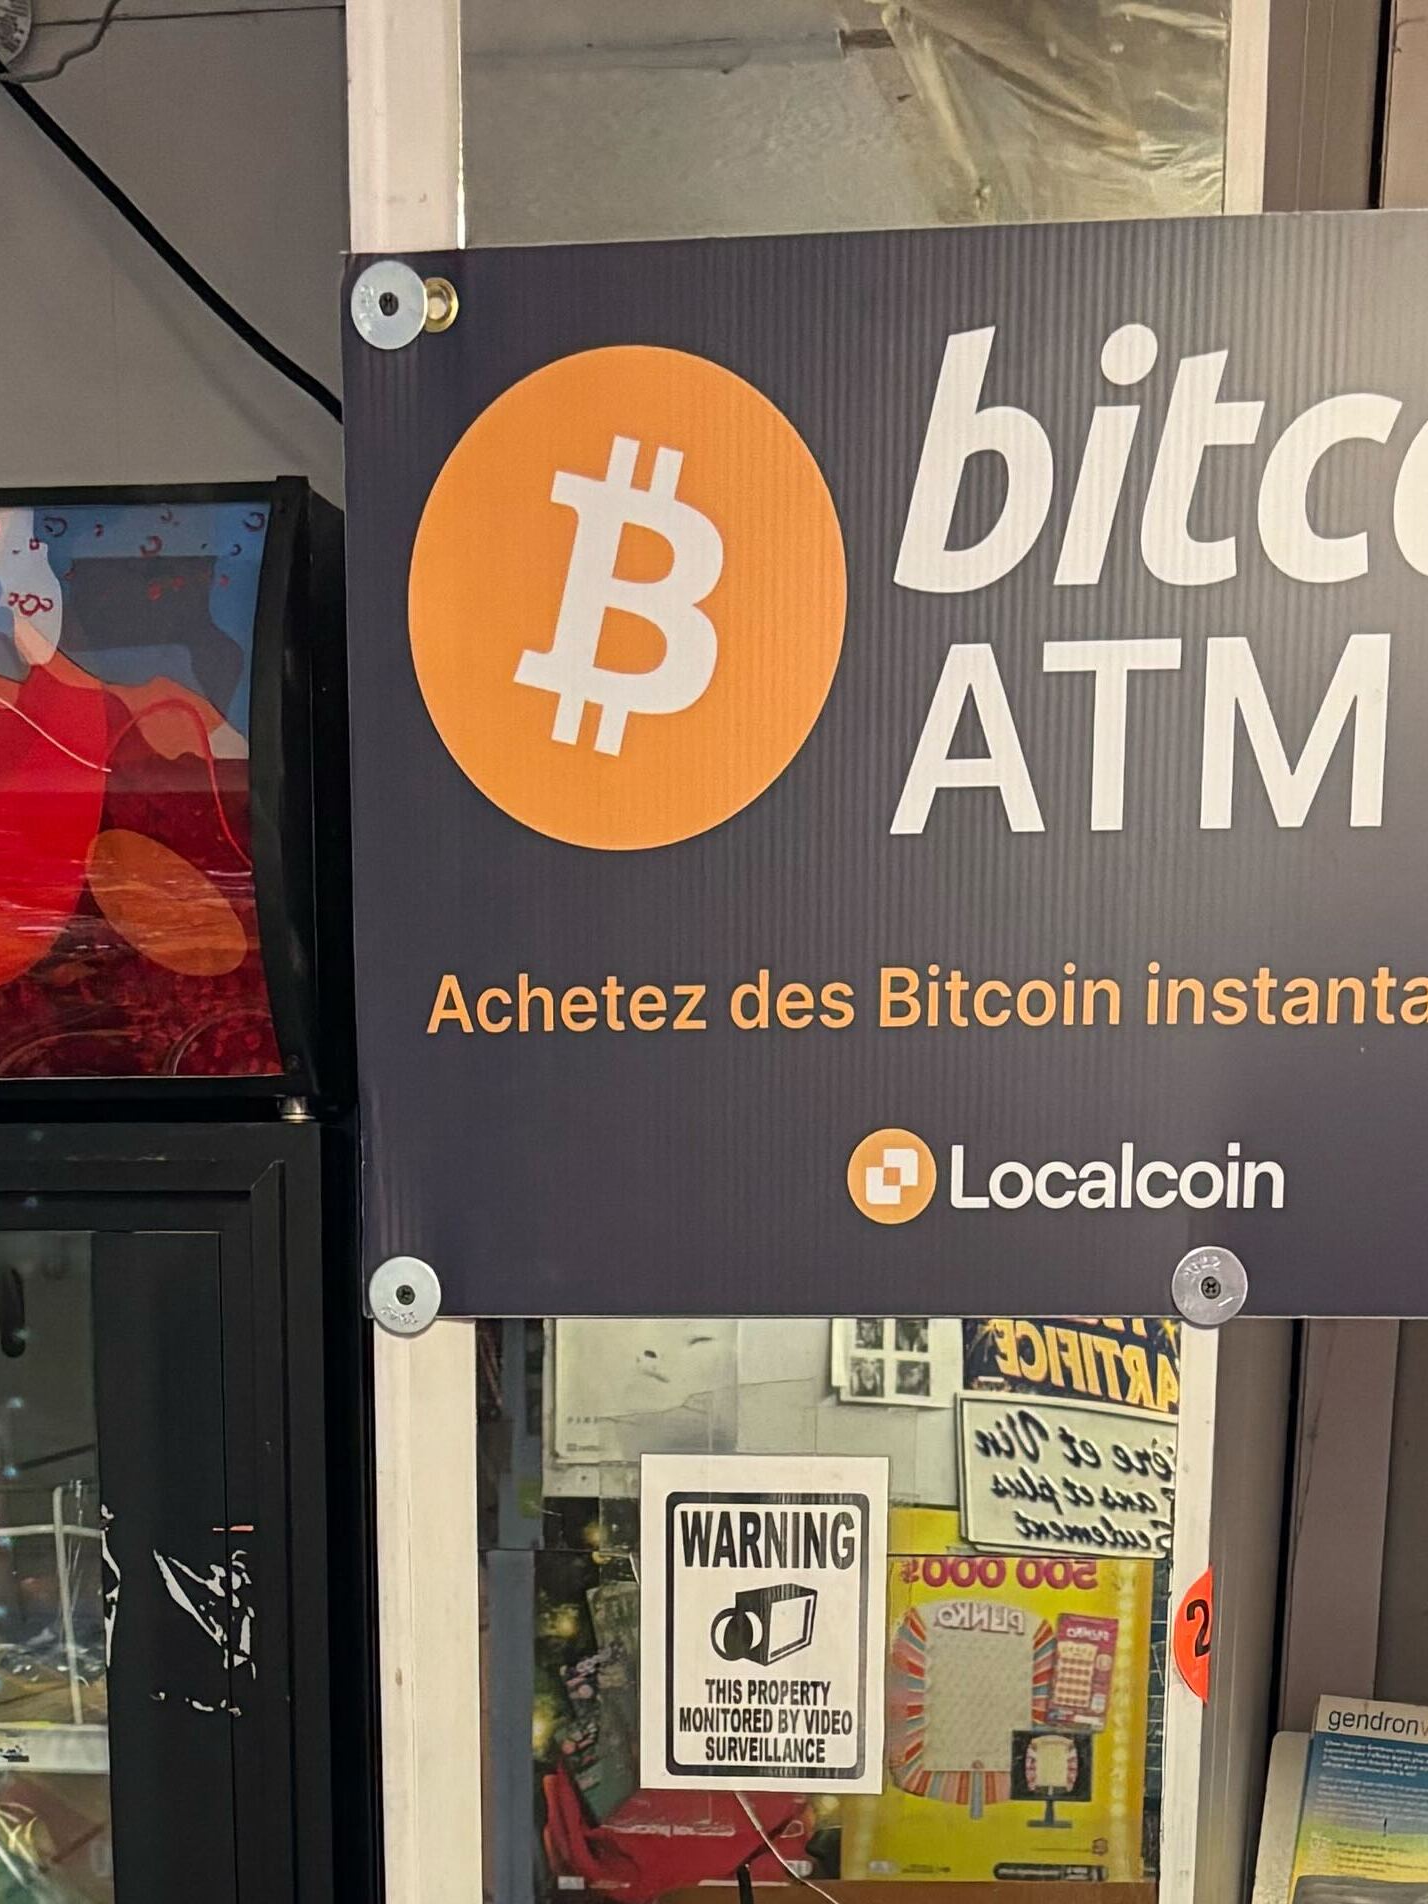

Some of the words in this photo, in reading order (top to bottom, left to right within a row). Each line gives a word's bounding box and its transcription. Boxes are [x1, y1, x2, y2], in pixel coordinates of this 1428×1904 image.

[889, 633, 1392, 834] ATM
[425, 972, 707, 1035] Achetez
[728, 966, 854, 1032] des
[877, 963, 1123, 1030] Bitcoin
[948, 1142, 1286, 1212] Localcoin
[680, 1509, 855, 1571] WARNING
[679, 1707, 774, 1735] MONITORED
[777, 1708, 799, 1735] BY
[802, 1708, 853, 1736] VIDEO
[705, 1679, 744, 1705] THIS
[747, 1680, 831, 1707] PROPERTY
[704, 1736, 827, 1764] SURVEILLANCE
